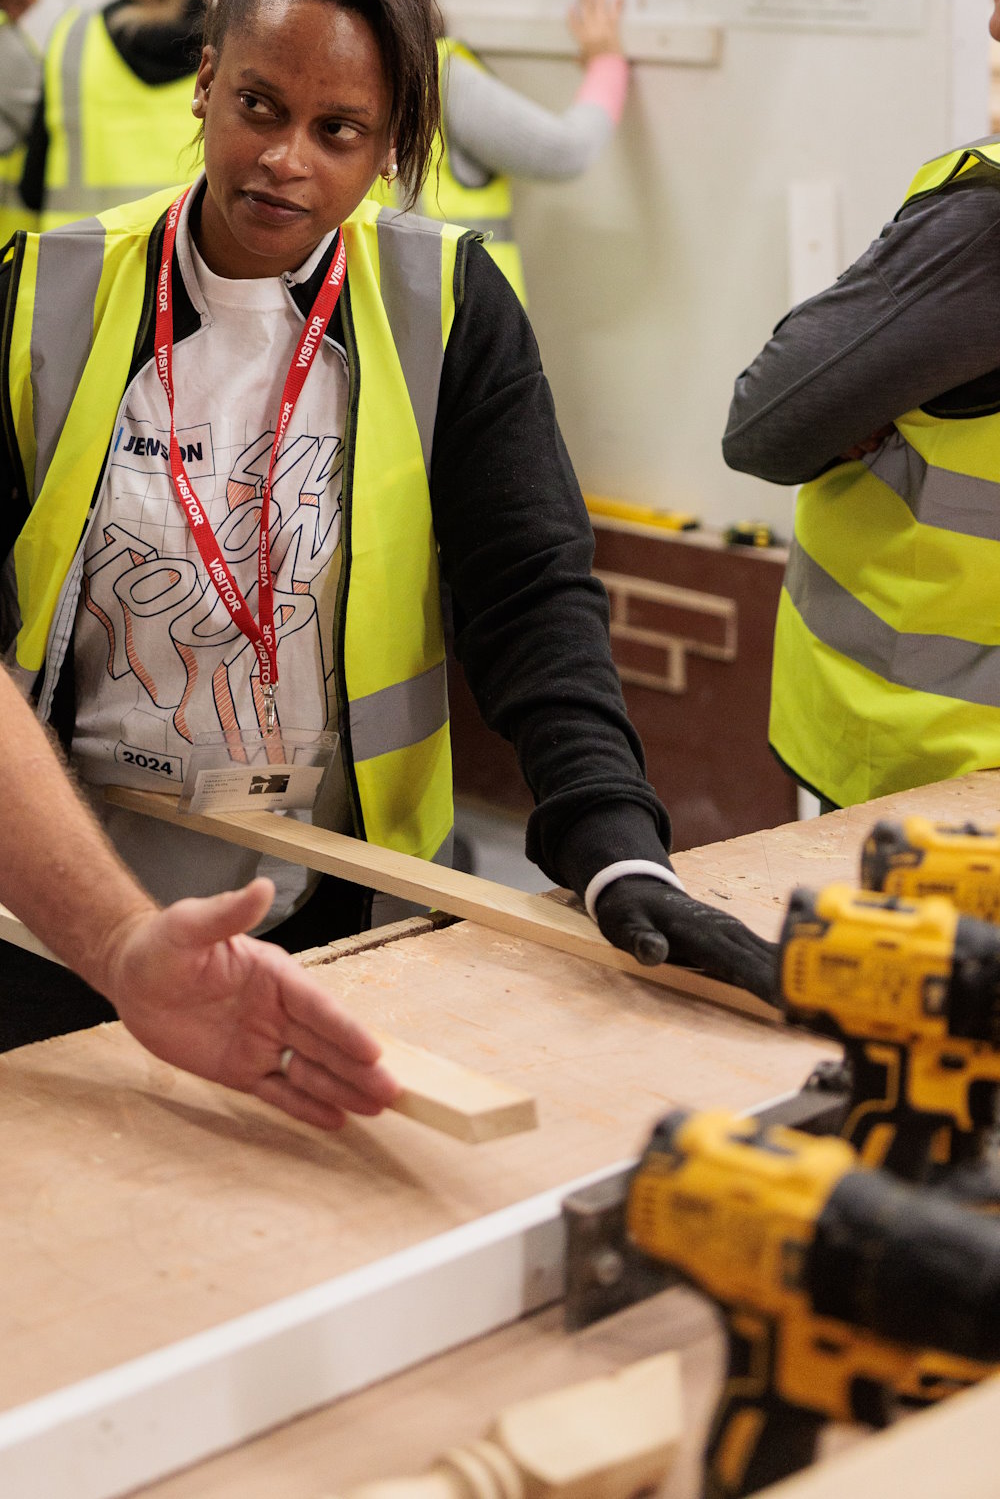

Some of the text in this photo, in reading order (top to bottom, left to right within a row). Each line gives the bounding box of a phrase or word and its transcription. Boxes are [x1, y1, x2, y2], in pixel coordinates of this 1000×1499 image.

[158, 259, 170, 314] VISITOR
[327, 239, 347, 287] VISITO
[296, 314, 326, 369] VISITOR
[175, 473, 205, 527] VISITOR
[208, 557, 242, 613] VISITOR
[259, 530, 268, 588] VISITOR
[255, 639, 271, 684] VISITO
[122, 750, 174, 776] 2024
